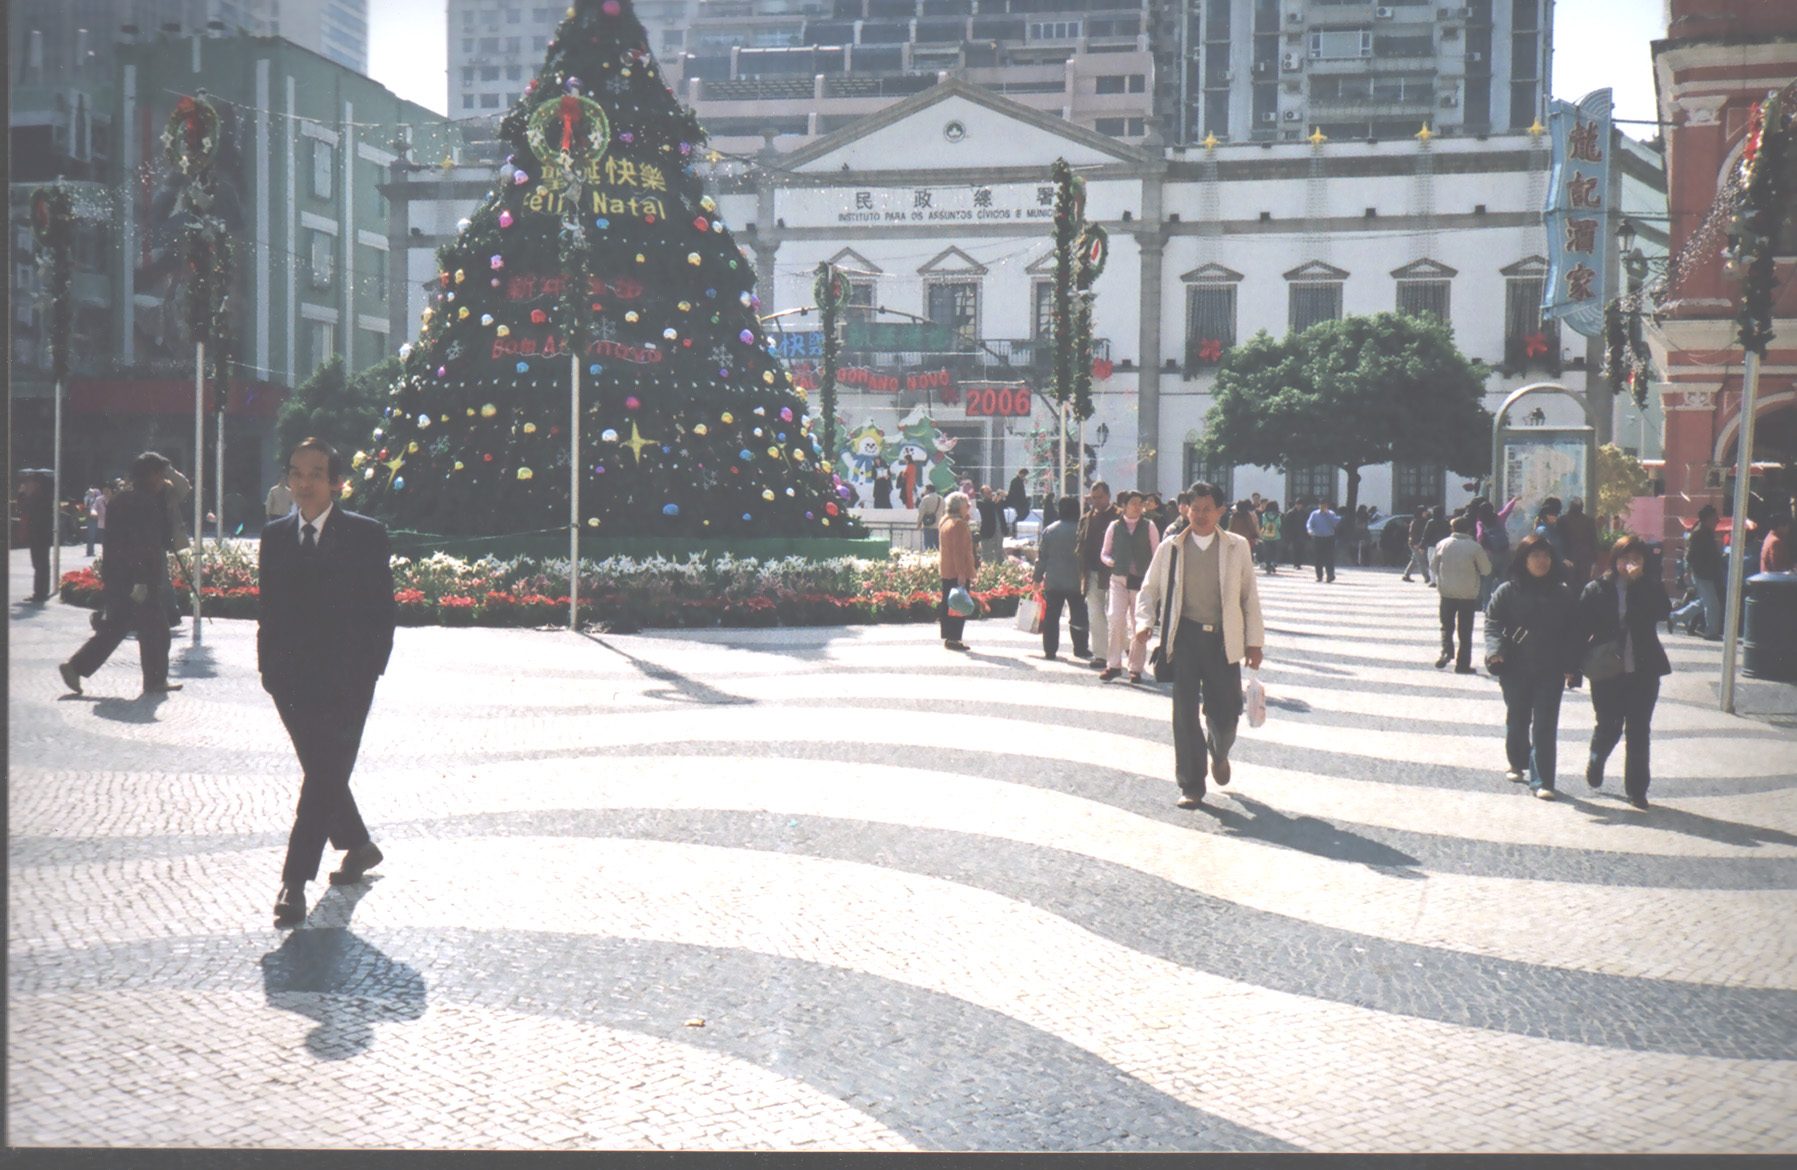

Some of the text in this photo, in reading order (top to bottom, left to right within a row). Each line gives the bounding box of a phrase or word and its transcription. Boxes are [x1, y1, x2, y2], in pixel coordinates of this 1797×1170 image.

[592, 190, 666, 220] Natal
[838, 211, 881, 222] INSTITUTO
[885, 211, 906, 221] PARA
[911, 211, 923, 221] OS
[928, 209, 972, 221] ASSUNTOS
[966, 389, 1030, 416] 2006
